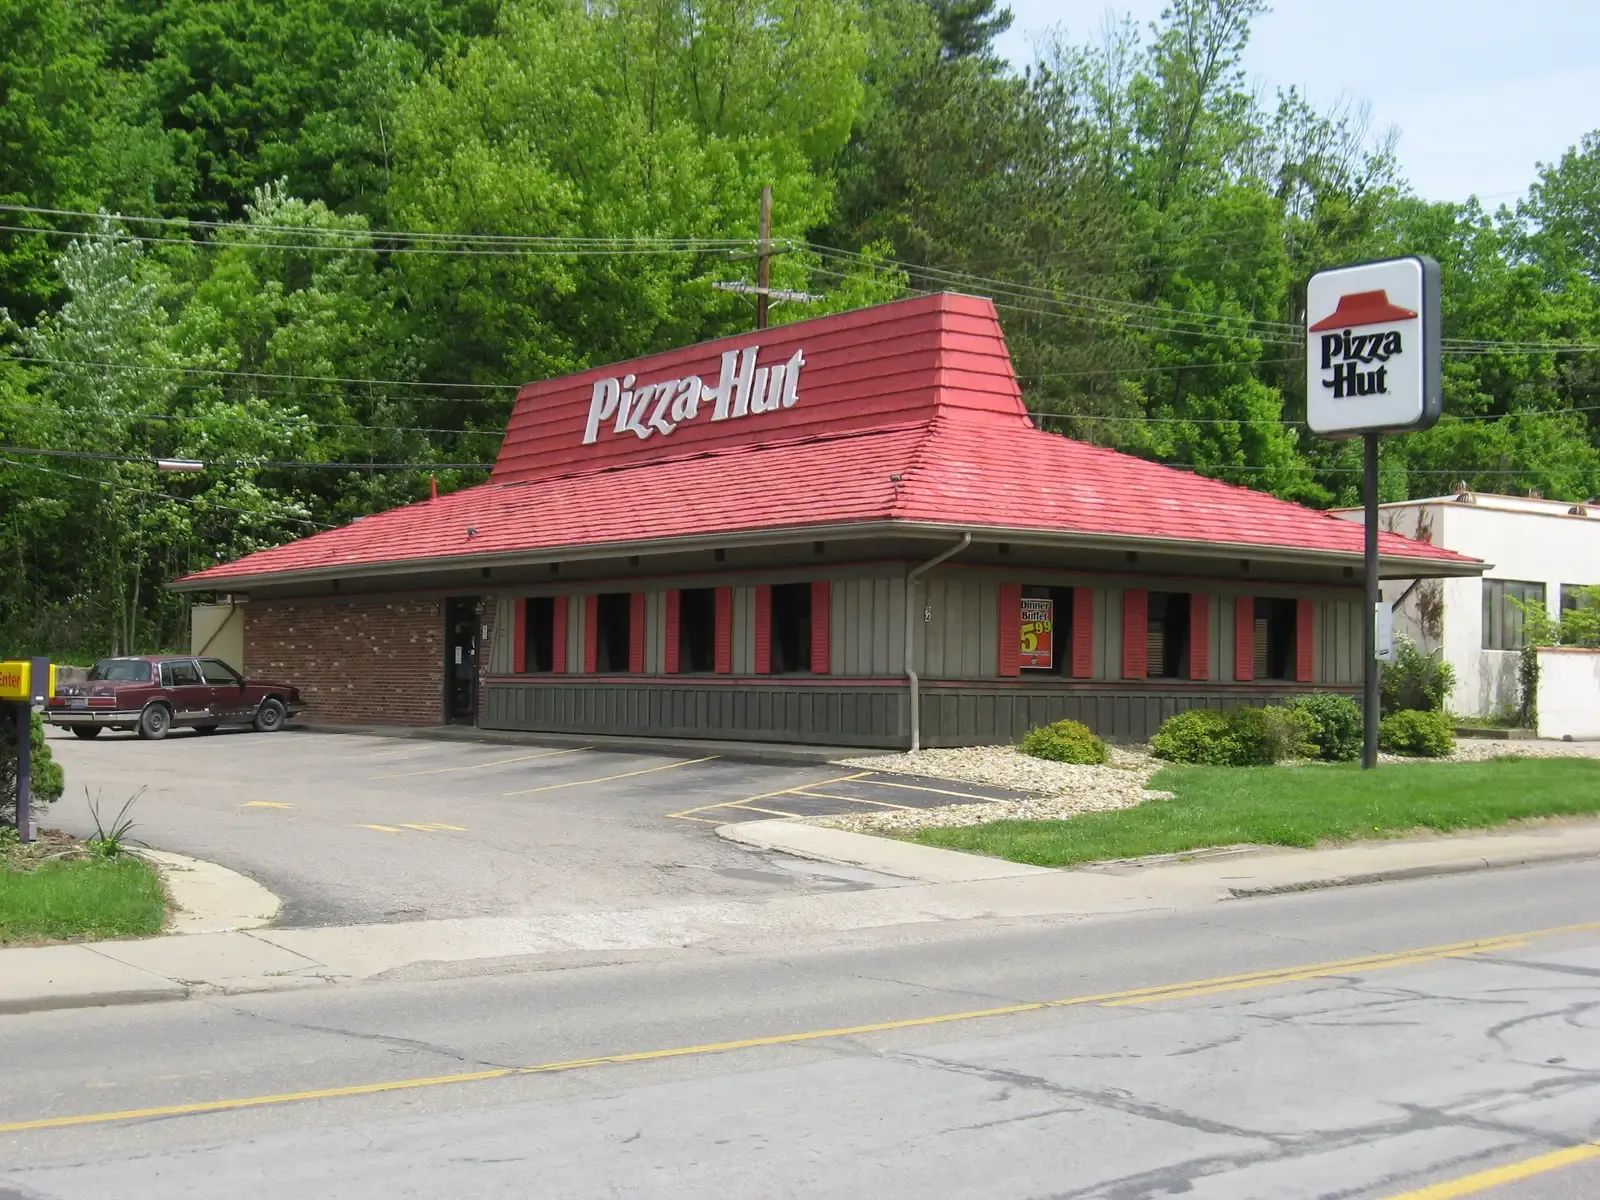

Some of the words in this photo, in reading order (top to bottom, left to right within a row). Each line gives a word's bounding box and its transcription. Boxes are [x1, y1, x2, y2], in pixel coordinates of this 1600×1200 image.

[1321, 329, 1403, 369] Pizza
[582, 374, 703, 444] Pizza
[701, 345, 806, 421] Hut
[1322, 361, 1388, 399] Hut
[1021, 601, 1049, 610] Dinner
[1022, 611, 1048, 620] Buffet
